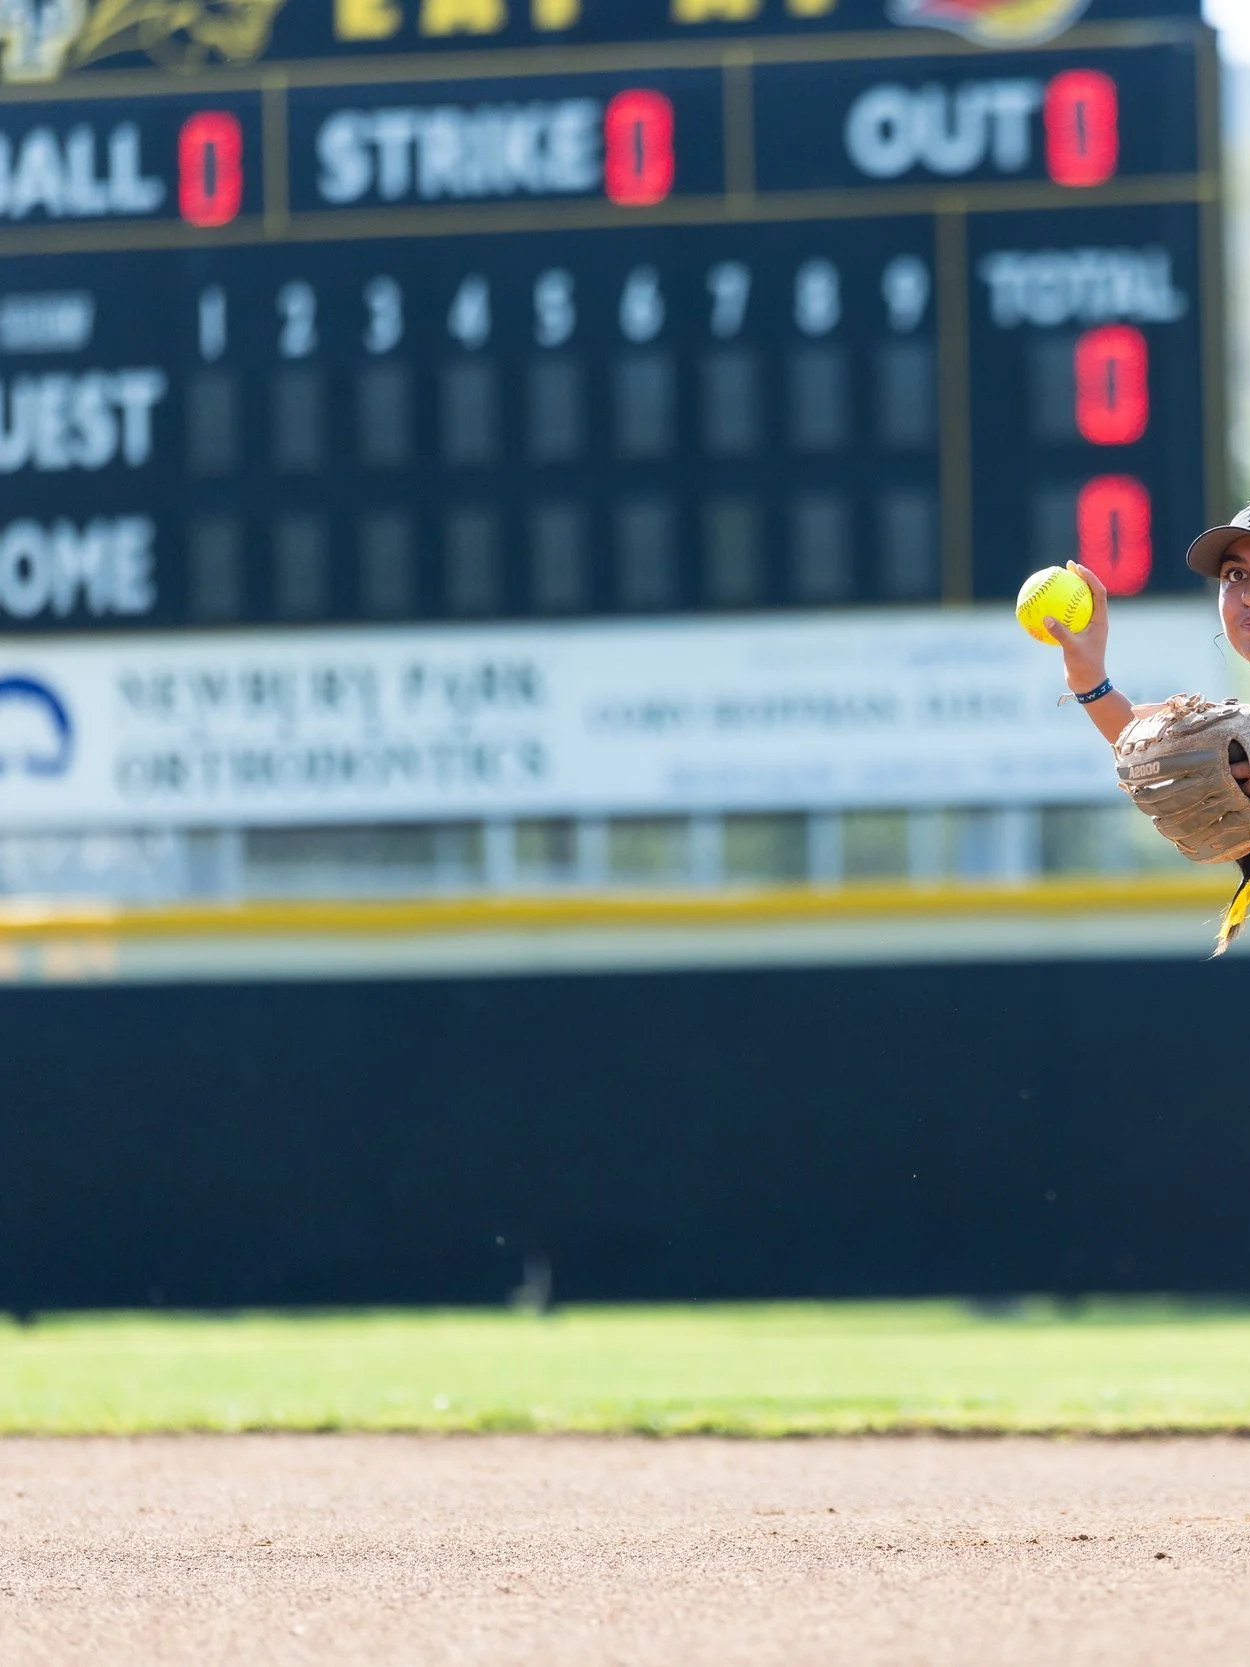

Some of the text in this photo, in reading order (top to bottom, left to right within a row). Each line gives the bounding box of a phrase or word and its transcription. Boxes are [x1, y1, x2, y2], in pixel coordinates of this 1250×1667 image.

[0, 122, 166, 220] ALL
[178, 110, 243, 228] 0
[317, 99, 604, 203] STRIKE
[604, 89, 675, 207] 0
[845, 82, 1040, 178] OUT
[1044, 69, 1119, 187] 0
[199, 253, 931, 362] 1 2 3 4 5 6 7 8 9
[979, 246, 1187, 329] TOTAL
[1074, 324, 1149, 446] 0
[1077, 474, 1152, 596] 0
[1128, 760, 1161, 780] A2000
